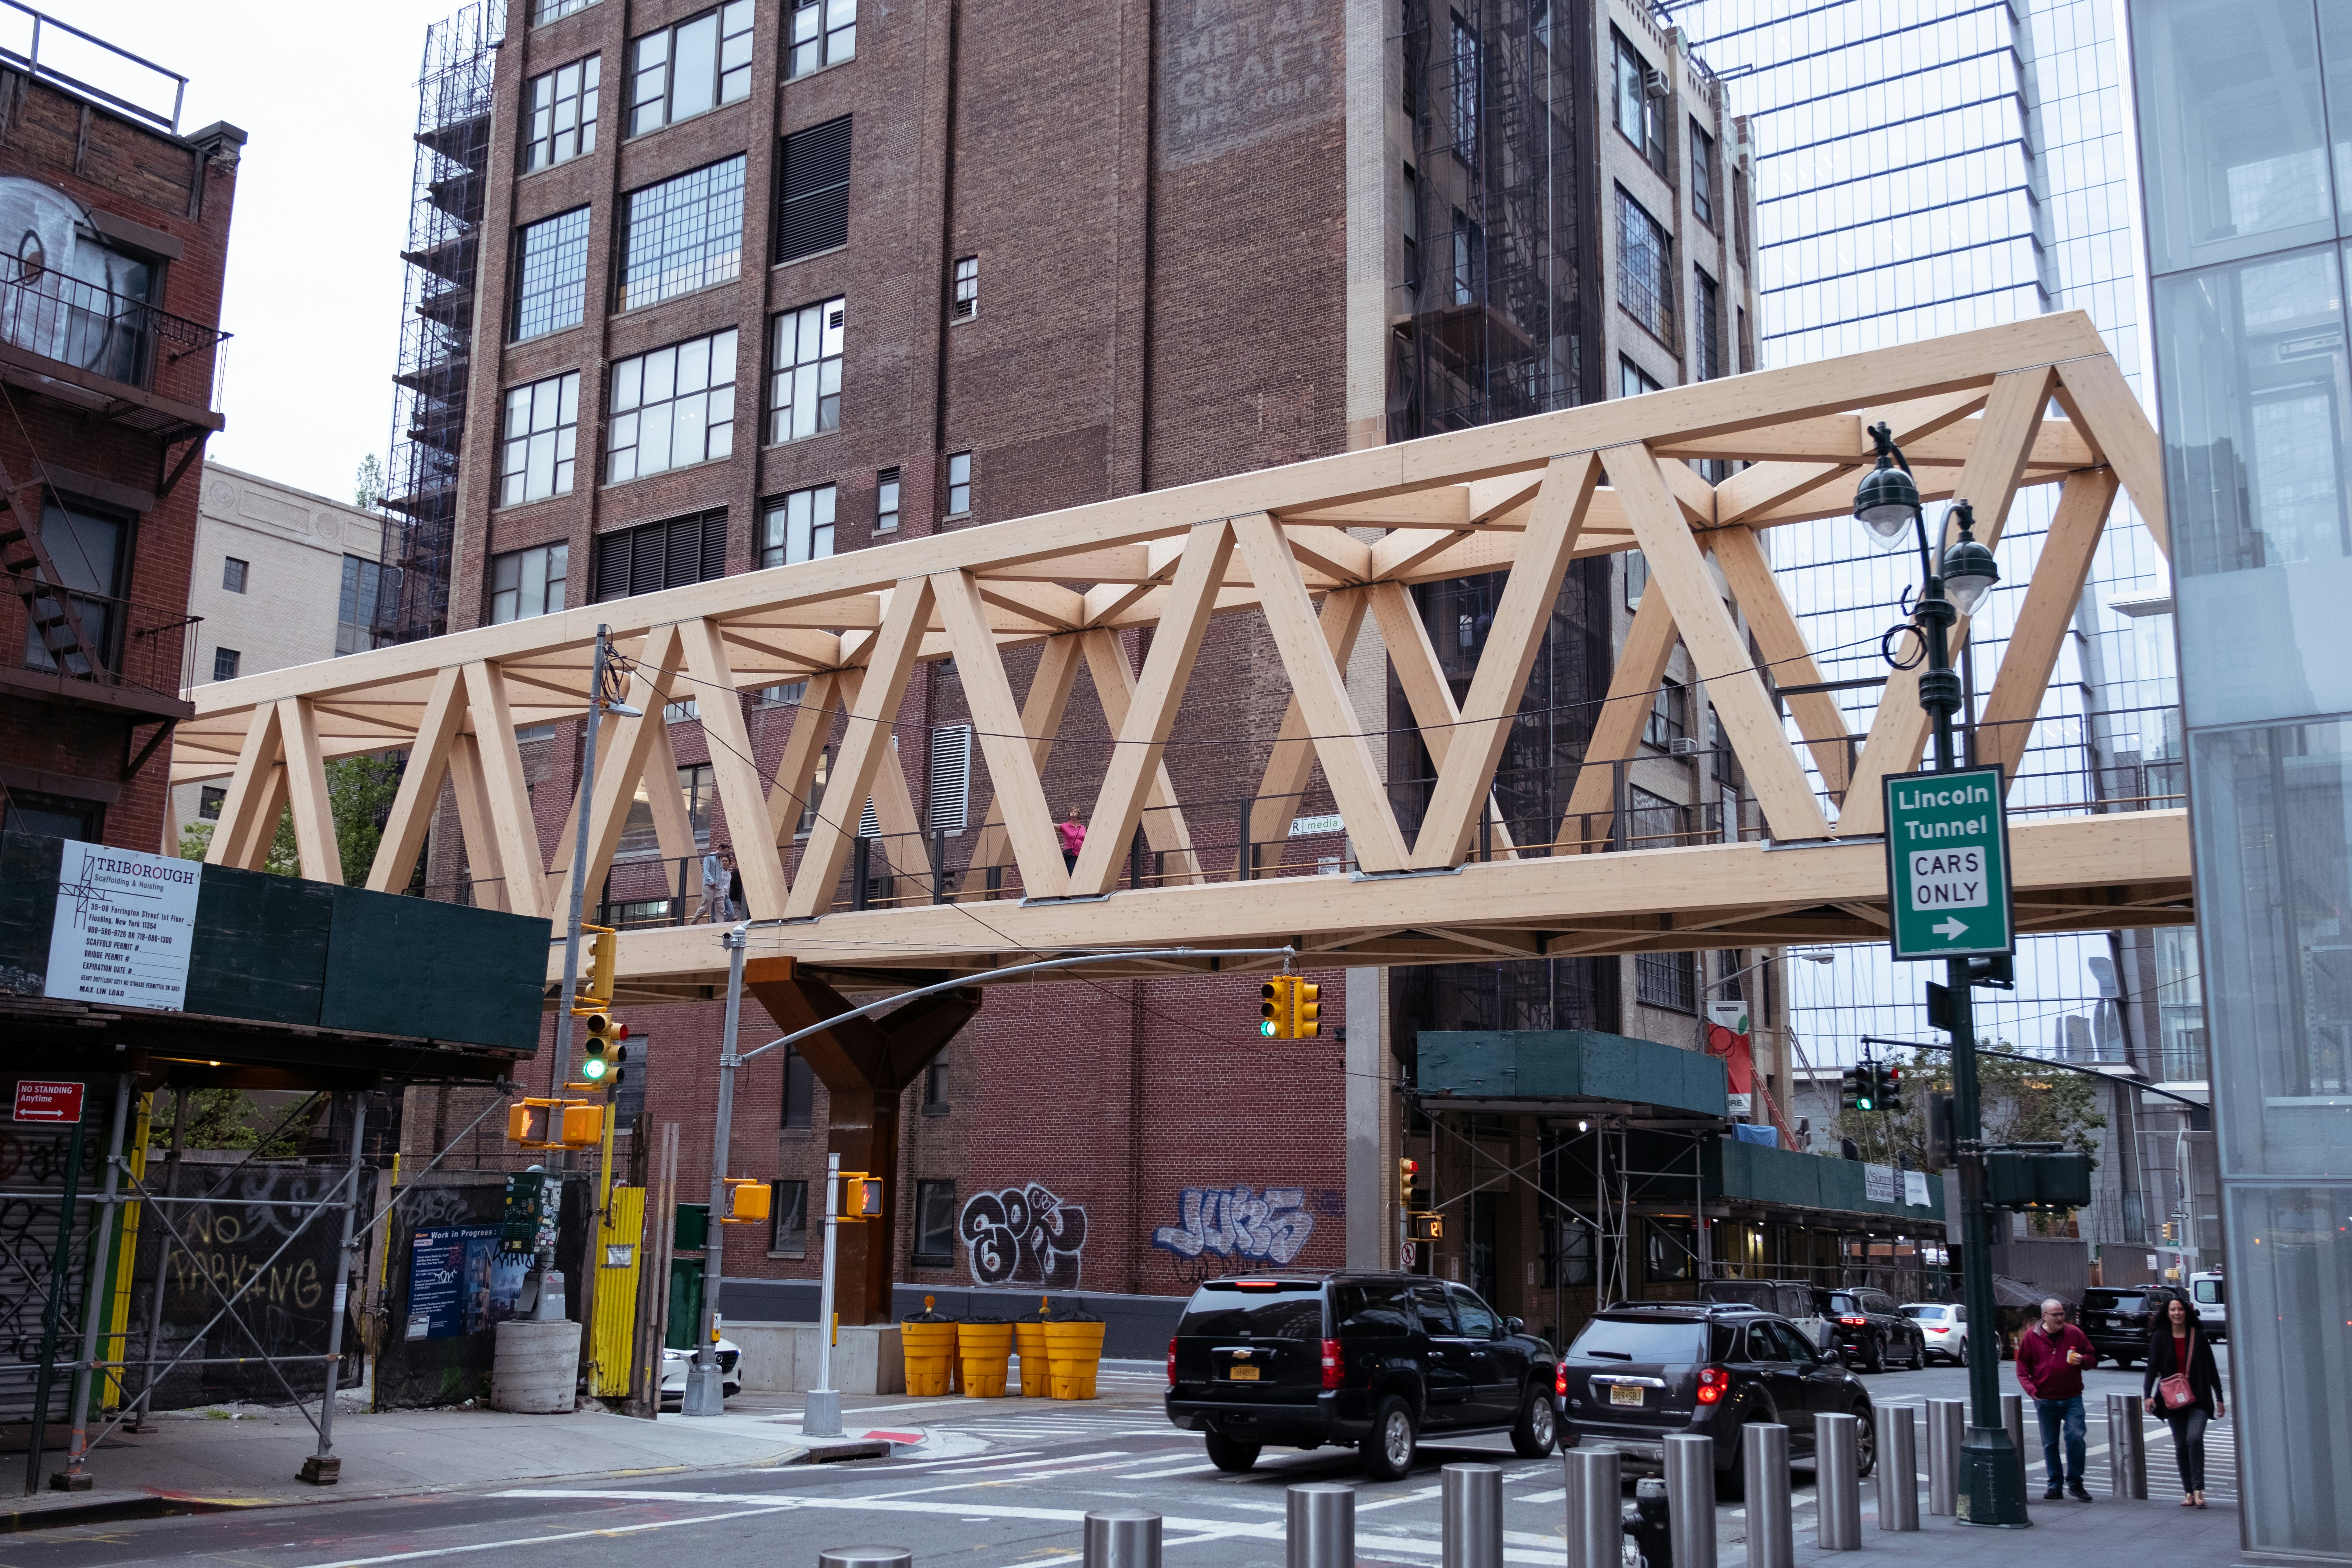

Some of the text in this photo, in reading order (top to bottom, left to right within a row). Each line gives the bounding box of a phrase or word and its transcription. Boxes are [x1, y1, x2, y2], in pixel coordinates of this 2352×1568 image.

[1899, 785, 1989, 810] Lincoln
[1307, 819, 1338, 829] media
[1905, 815, 1988, 840] Tunnel
[97, 858, 194, 885] TRIBOROUGH
[1916, 853, 1978, 876] CARS
[95, 874, 129, 887] Scaffolding
[139, 881, 164, 892] Hoisting
[1917, 882, 1979, 904] ONLY
[89, 914, 113, 924] Flushing,
[91, 903, 109, 912] 35-06
[111, 906, 139, 917] Farrington
[142, 911, 159, 920] Street
[86, 938, 112, 948] SCAFFOLD
[114, 942, 133, 951] PERMIT
[84, 950, 103, 959] BRIDGE
[105, 952, 124, 962] PERMIT
[83, 962, 112, 972] EXPIRATION
[113, 966, 126, 974] DATE
[21, 1094, 52, 1103] Anytime
[34, 1086, 72, 1094] STANDING
[188, 1207, 240, 1243] NO
[167, 1249, 322, 1309] PARKING
[1613, 1391, 1641, 1401] B89 SBJ
